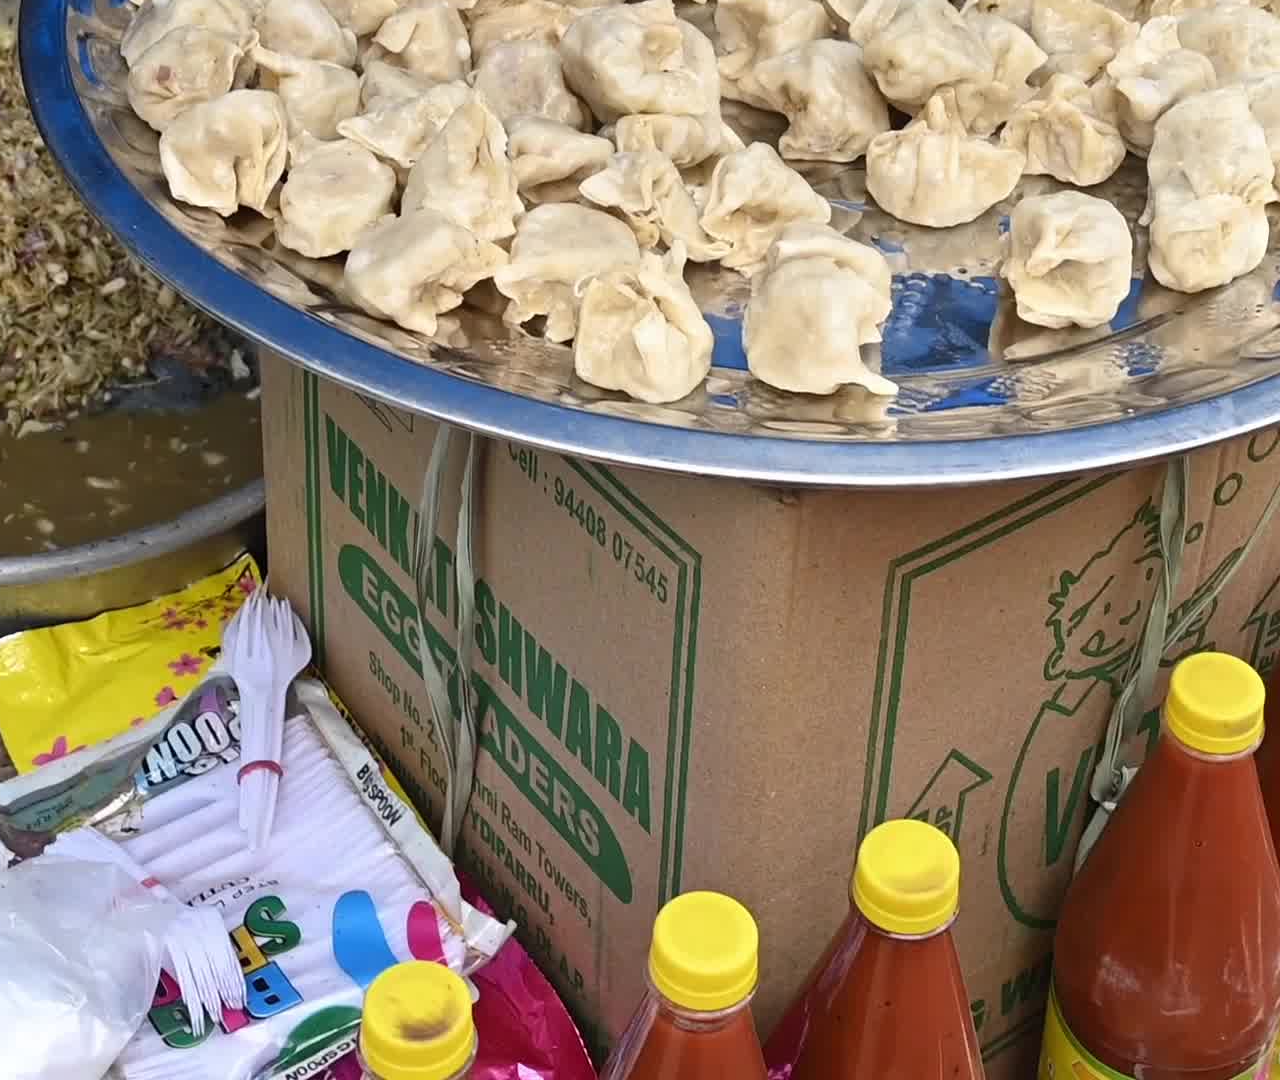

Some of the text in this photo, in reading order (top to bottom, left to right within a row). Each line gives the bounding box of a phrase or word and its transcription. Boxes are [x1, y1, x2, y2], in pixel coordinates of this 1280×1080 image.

[325, 413, 653, 834] VENKTSHWARA
[554, 476, 607, 547] 94408
[612, 535, 669, 605] 07545
[369, 651, 401, 706] Shop
[434, 646, 601, 858] TADERS
[420, 749, 448, 797] Floo
[501, 807, 532, 858] Ram
[535, 843, 592, 929] Towers,
